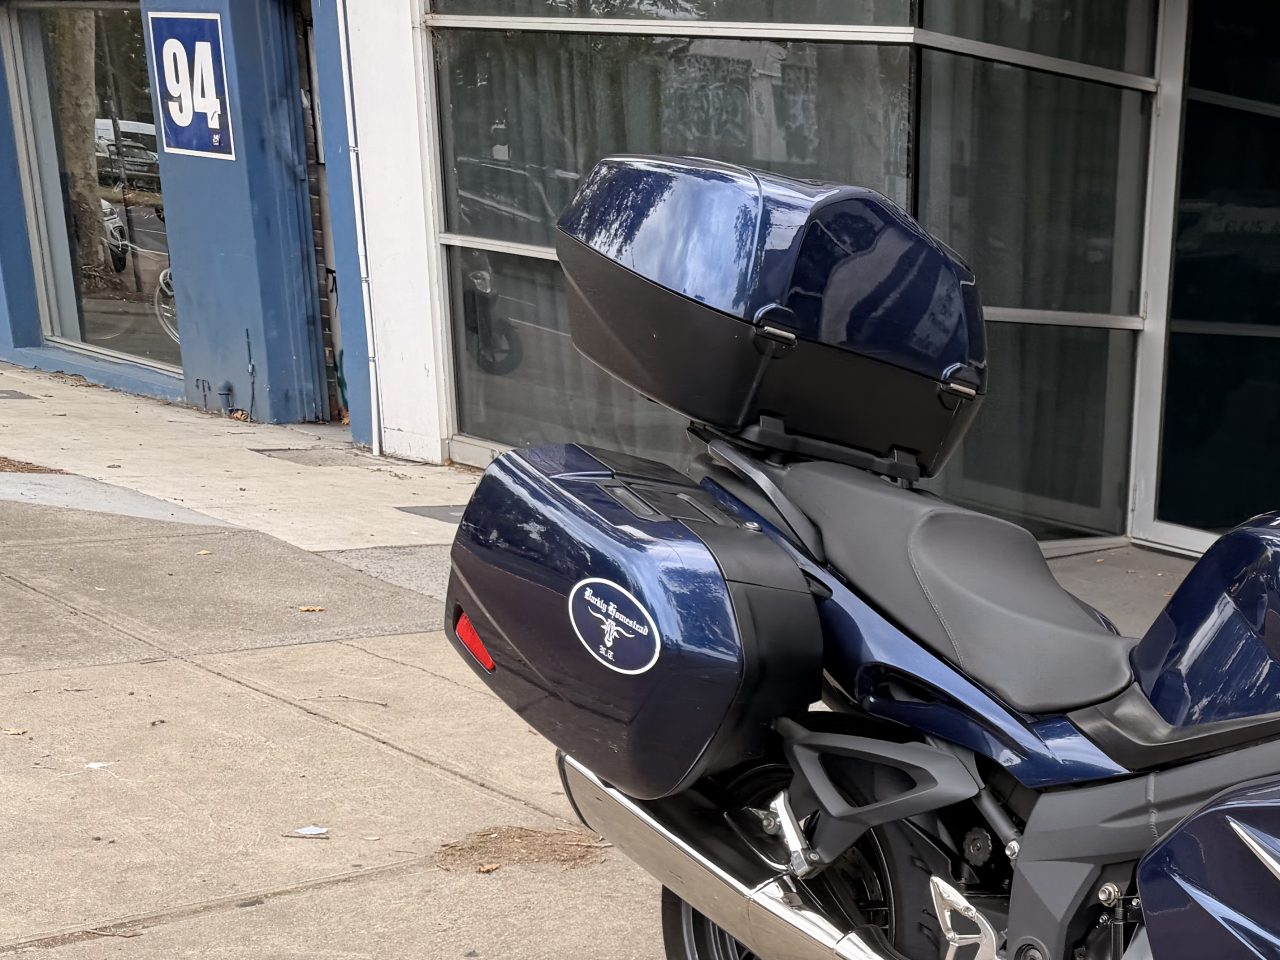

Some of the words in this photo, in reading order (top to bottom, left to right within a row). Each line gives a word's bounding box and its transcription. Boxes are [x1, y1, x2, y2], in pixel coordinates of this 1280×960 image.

[162, 38, 221, 129] 94
[584, 587, 608, 613] Barkly
[608, 602, 649, 636] Homestead
